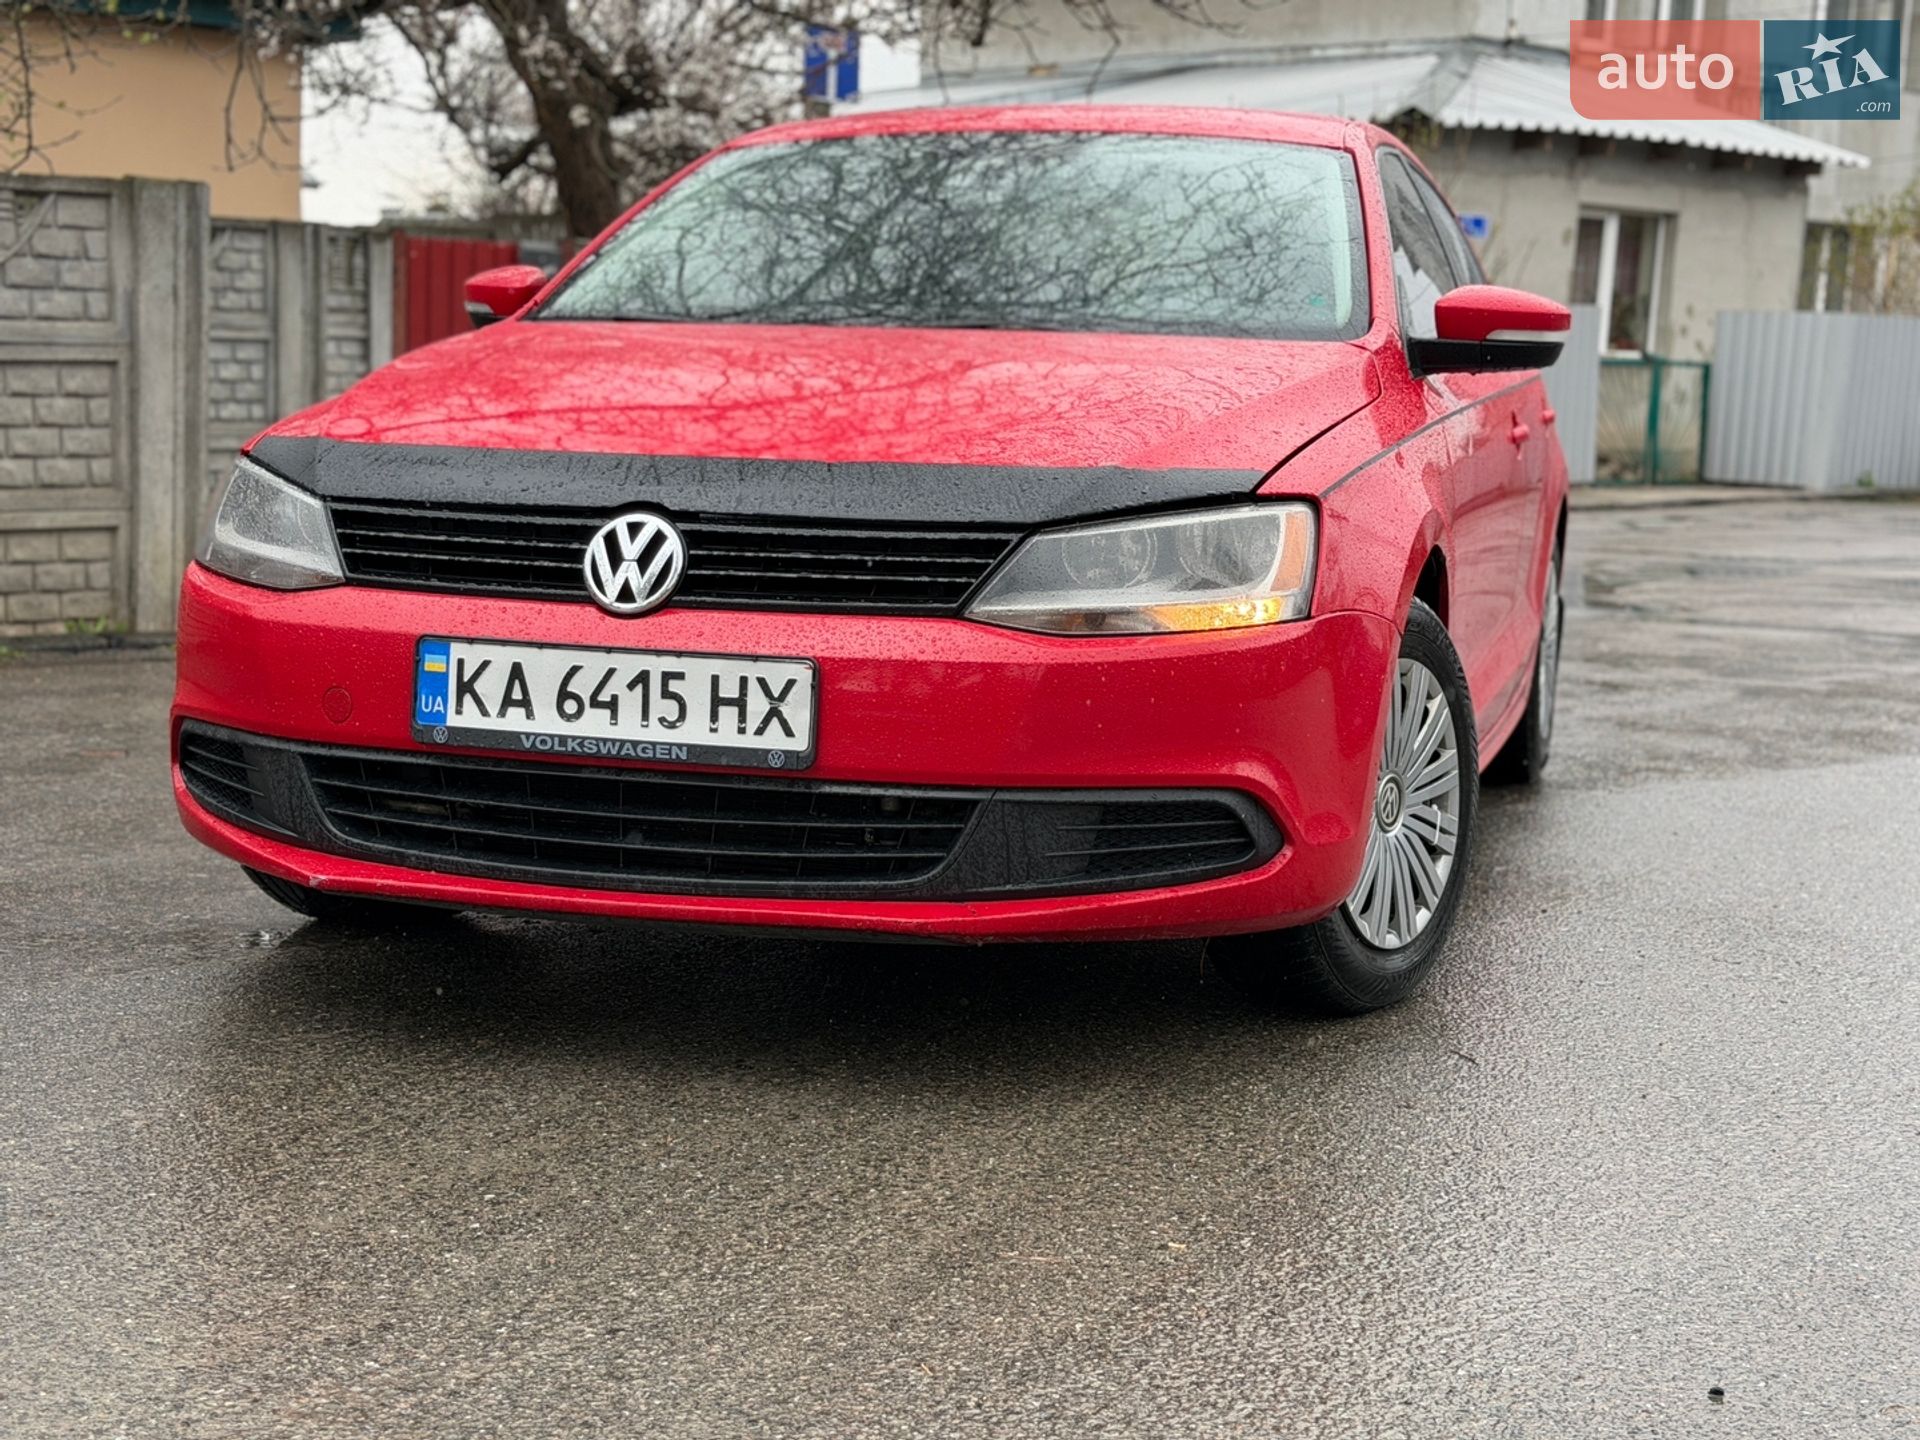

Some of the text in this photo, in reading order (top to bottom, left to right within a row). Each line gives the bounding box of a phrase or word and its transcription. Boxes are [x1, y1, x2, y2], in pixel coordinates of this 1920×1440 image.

[590, 513, 680, 606] VW
[420, 694, 446, 714] UA
[454, 657, 798, 738] KA 6415 HX
[520, 734, 688, 760] VOLKSWAGEN
